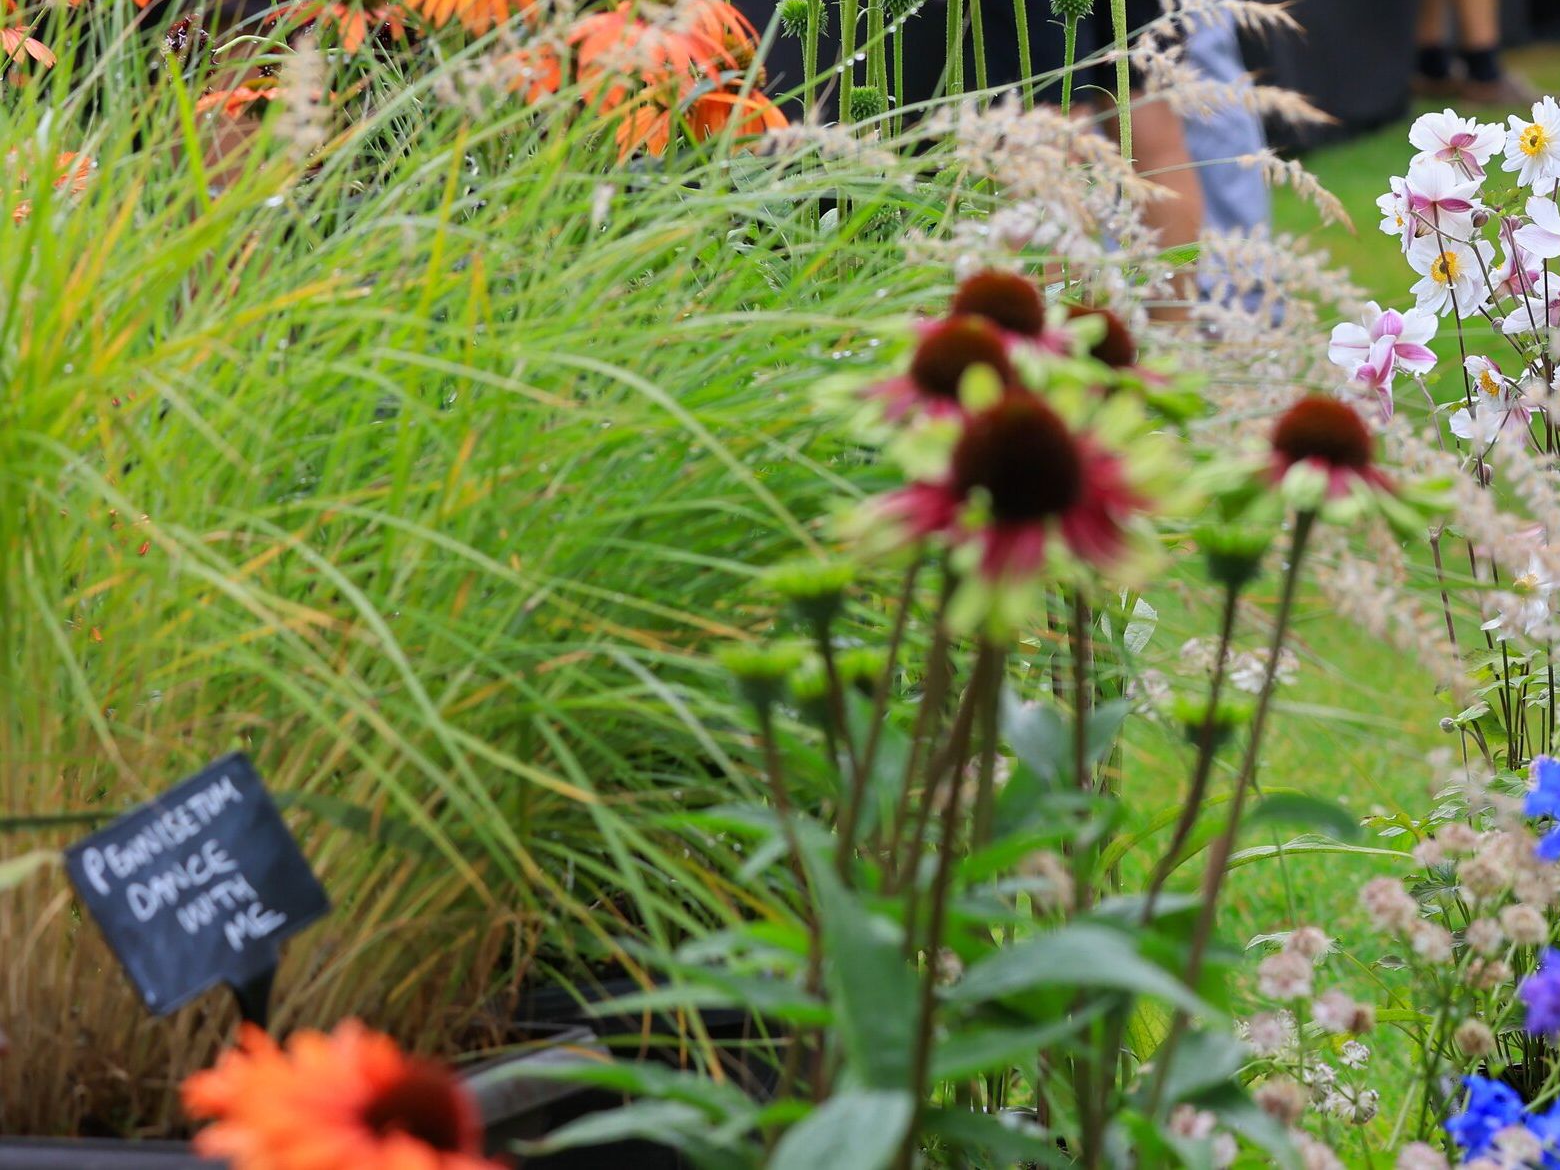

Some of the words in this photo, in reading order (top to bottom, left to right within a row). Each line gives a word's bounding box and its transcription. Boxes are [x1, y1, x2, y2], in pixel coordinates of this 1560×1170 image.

[126, 838, 239, 923] DANCE
[176, 872, 259, 935] WITH
[224, 901, 288, 953] ME
